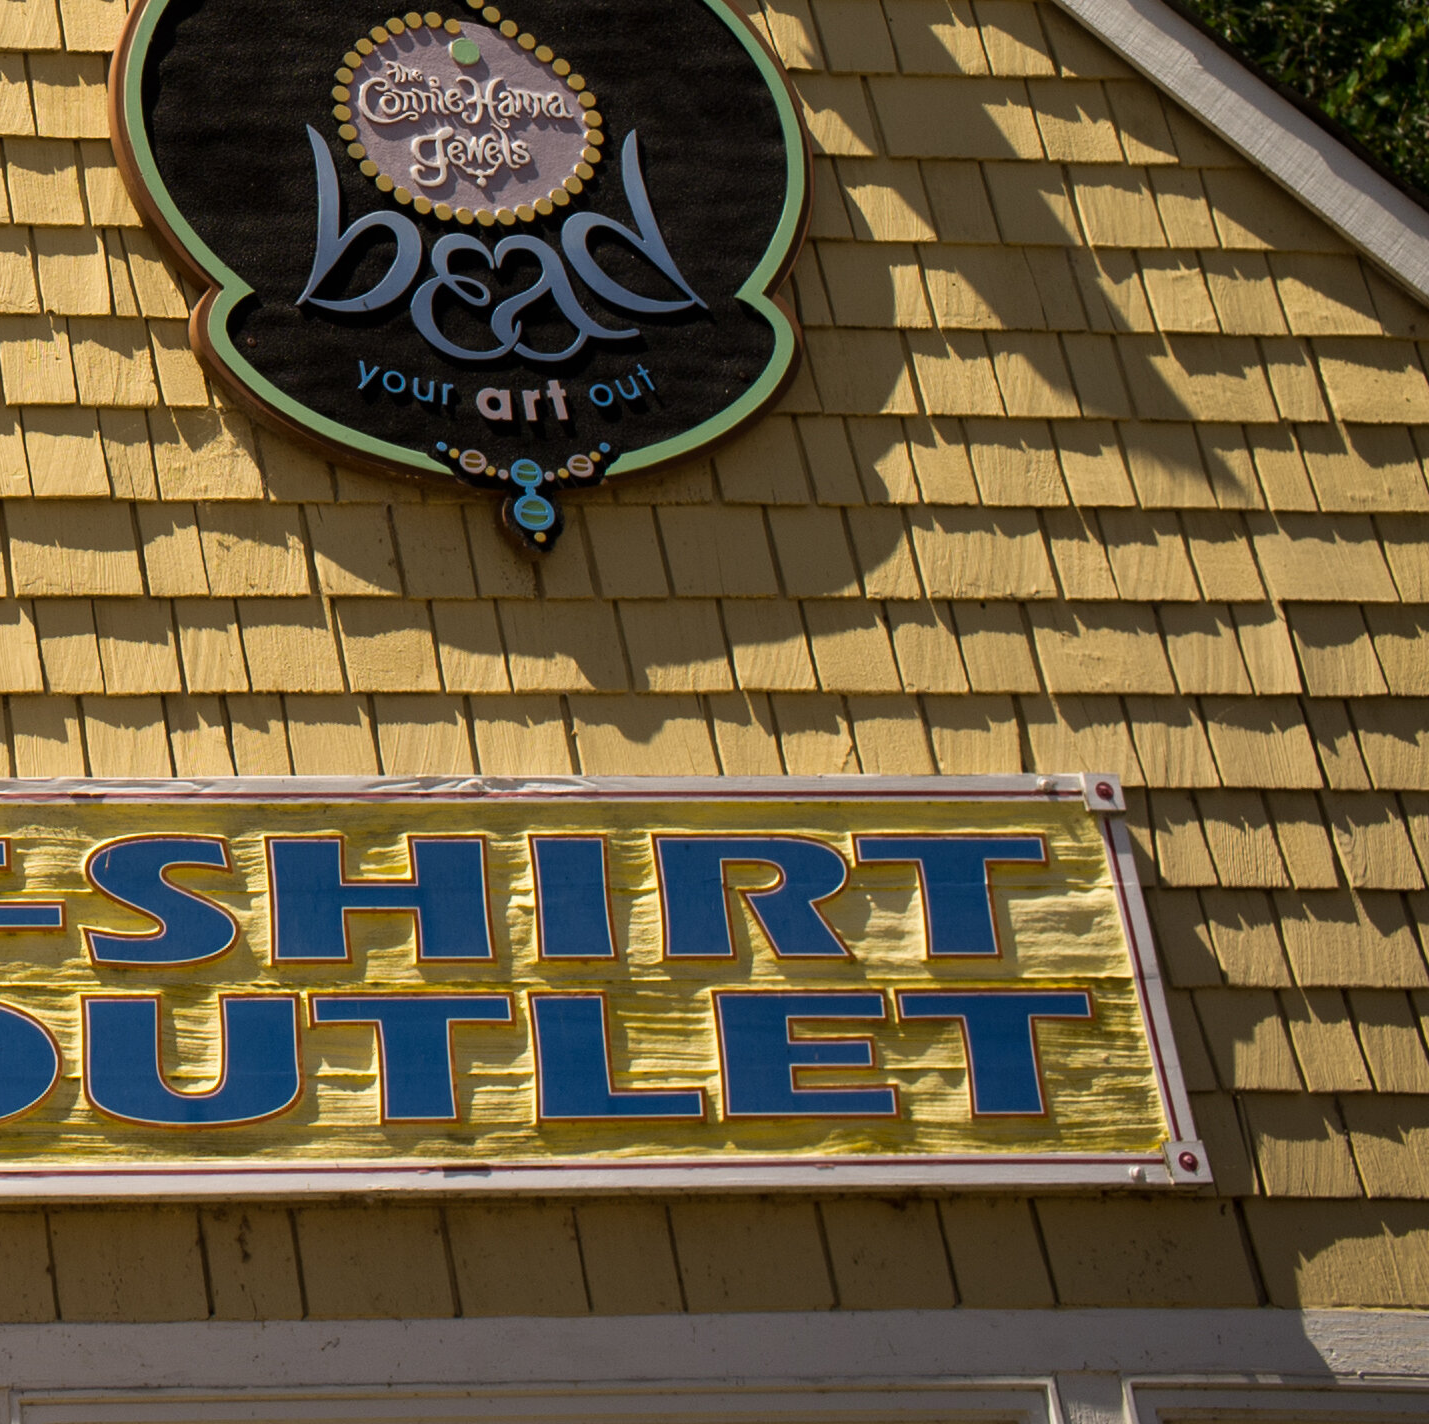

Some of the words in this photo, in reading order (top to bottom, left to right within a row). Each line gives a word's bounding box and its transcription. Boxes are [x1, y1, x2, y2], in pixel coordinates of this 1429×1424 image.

[387, 62, 423, 82] The
[356, 360, 454, 406] your
[475, 379, 569, 422] art
[587, 363, 657, 408] out
